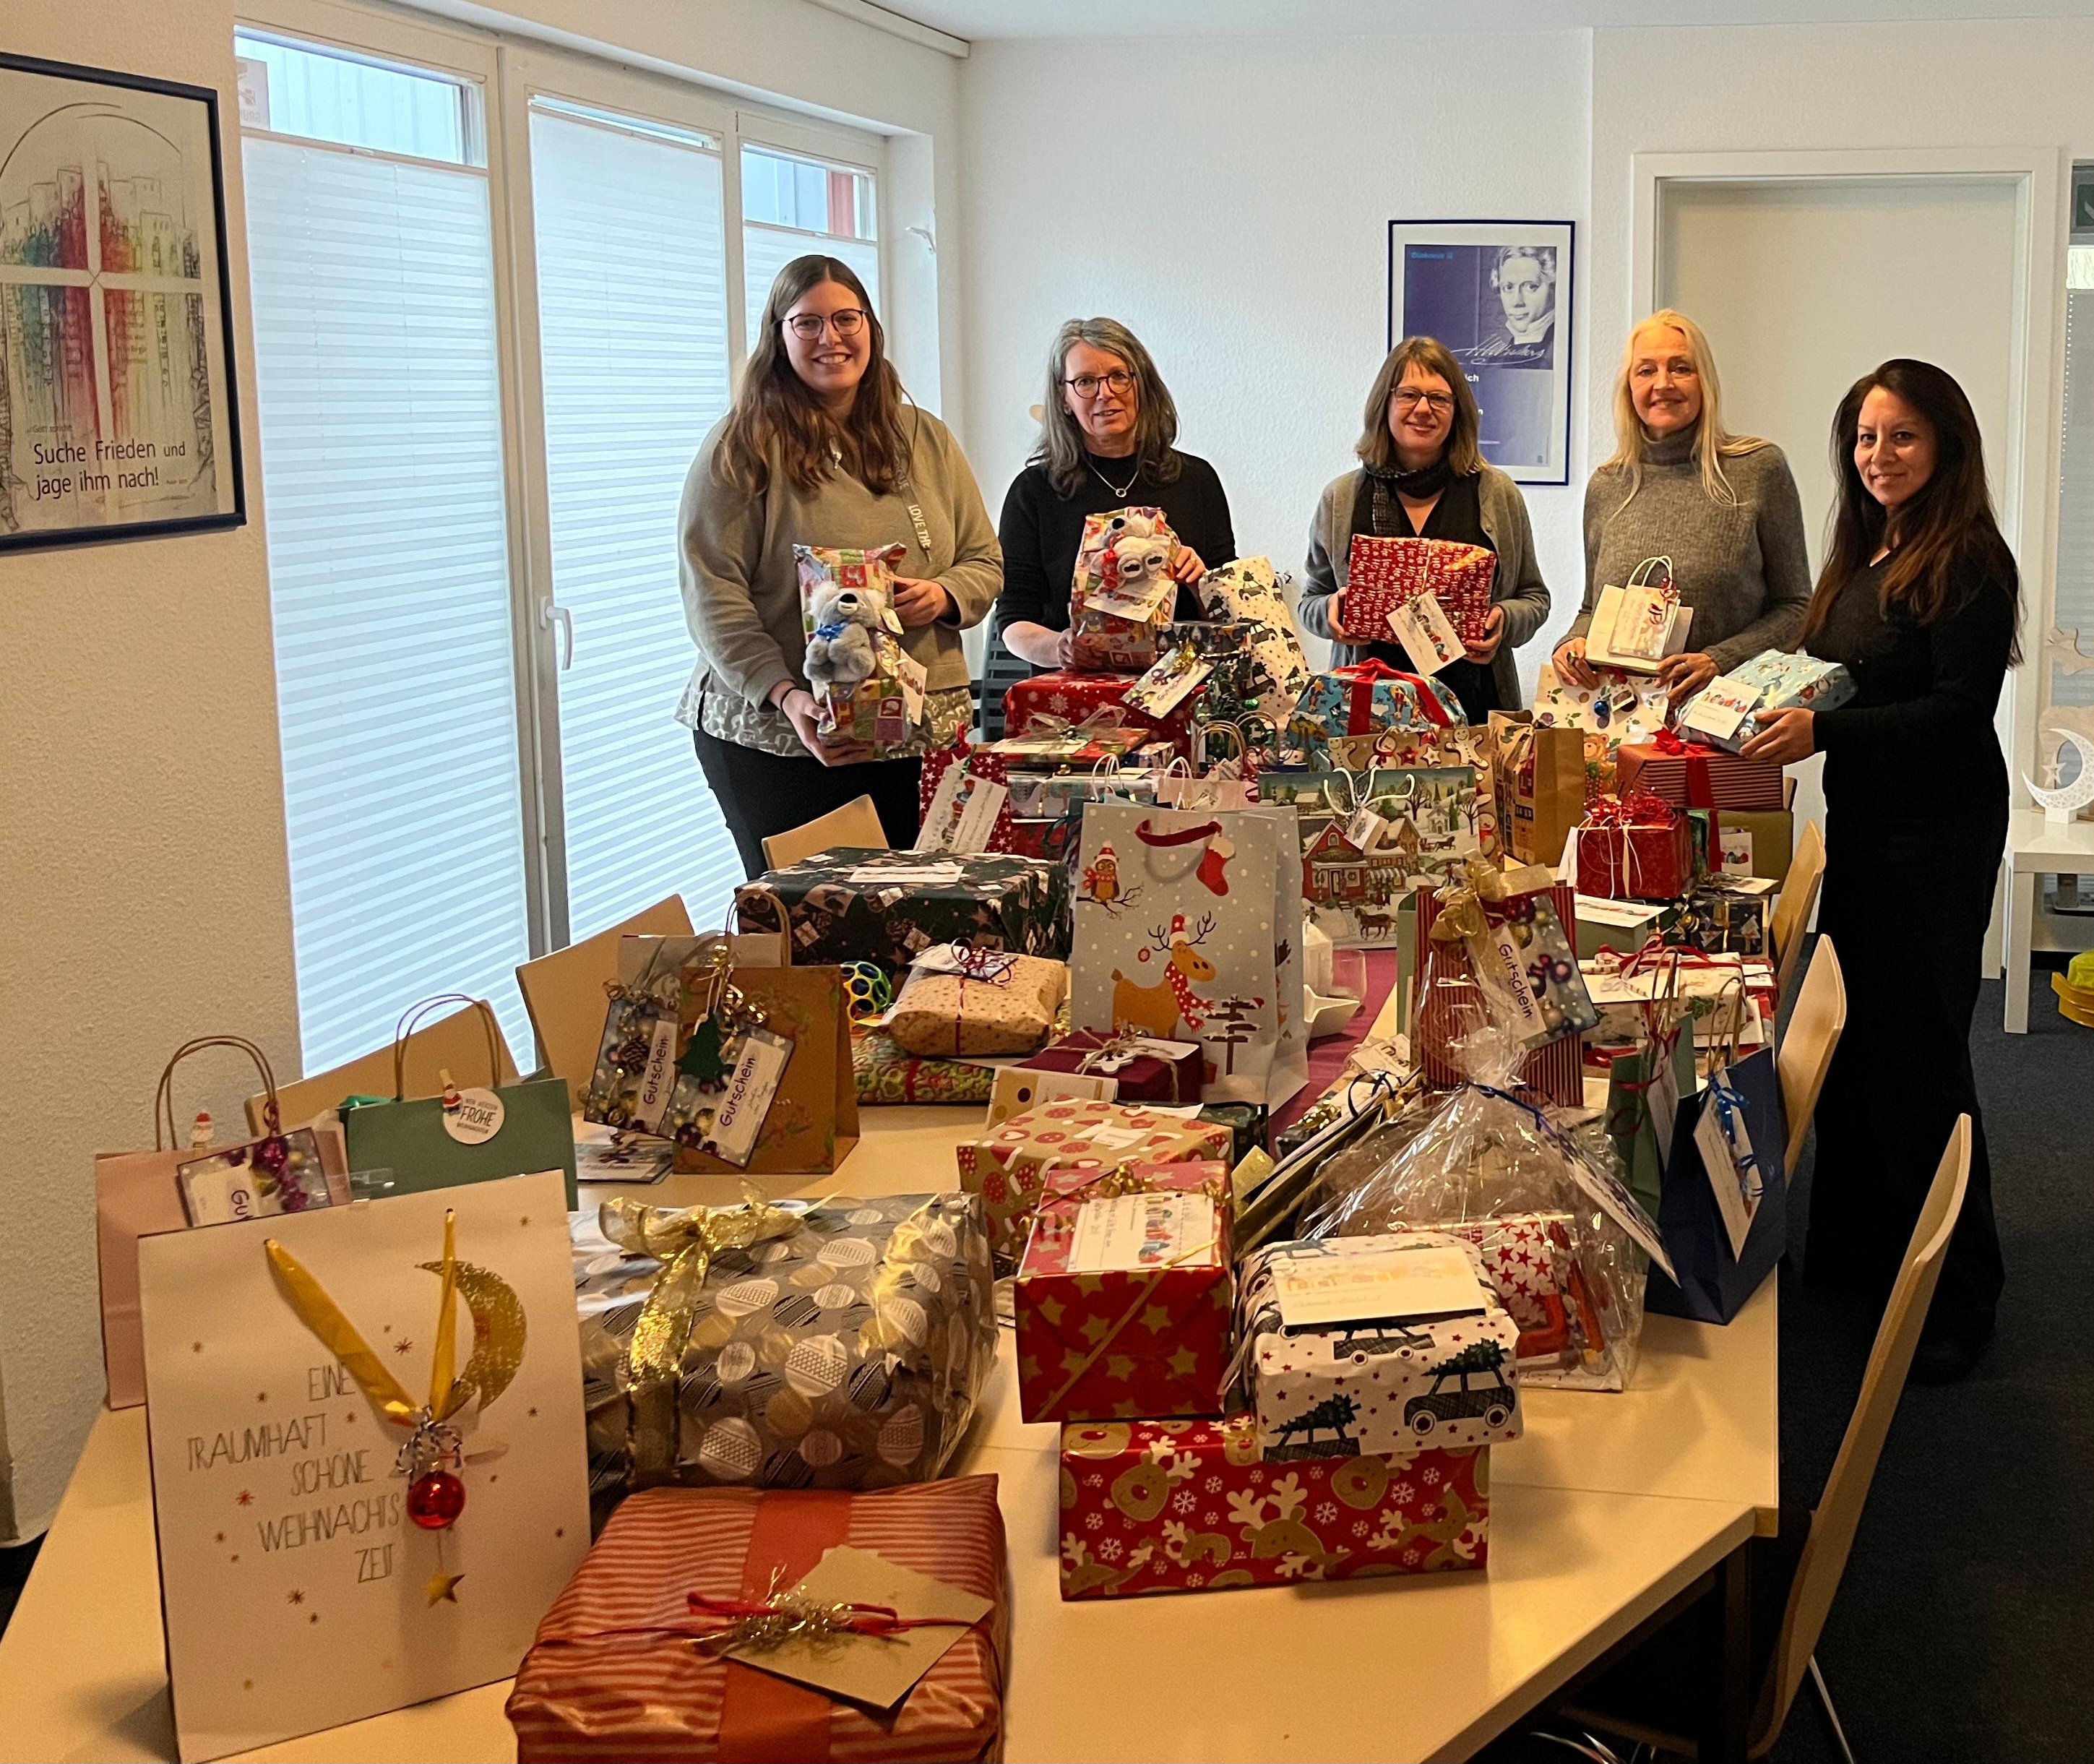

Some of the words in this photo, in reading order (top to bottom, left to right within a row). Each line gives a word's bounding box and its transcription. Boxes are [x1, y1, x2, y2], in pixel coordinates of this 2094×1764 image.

[34, 442, 86, 465] Suche
[95, 438, 156, 461] Frieden
[164, 441, 186, 457] und
[36, 474, 72, 500] jage
[79, 470, 111, 491] ihm
[119, 467, 159, 488] nach!
[908, 504, 926, 528] LOVE
[1499, 943, 1533, 1019] Gutschein
[643, 1036, 669, 1105] Gutschein
[720, 1056, 756, 1127] Gutschein
[460, 1106, 496, 1127] FROHE
[309, 1361, 356, 1401] EINE
[187, 1413, 327, 1471] TRAUMHAFT
[257, 1492, 400, 1552] WEIHNACHTS
[355, 1544, 394, 1583] ZEIT
